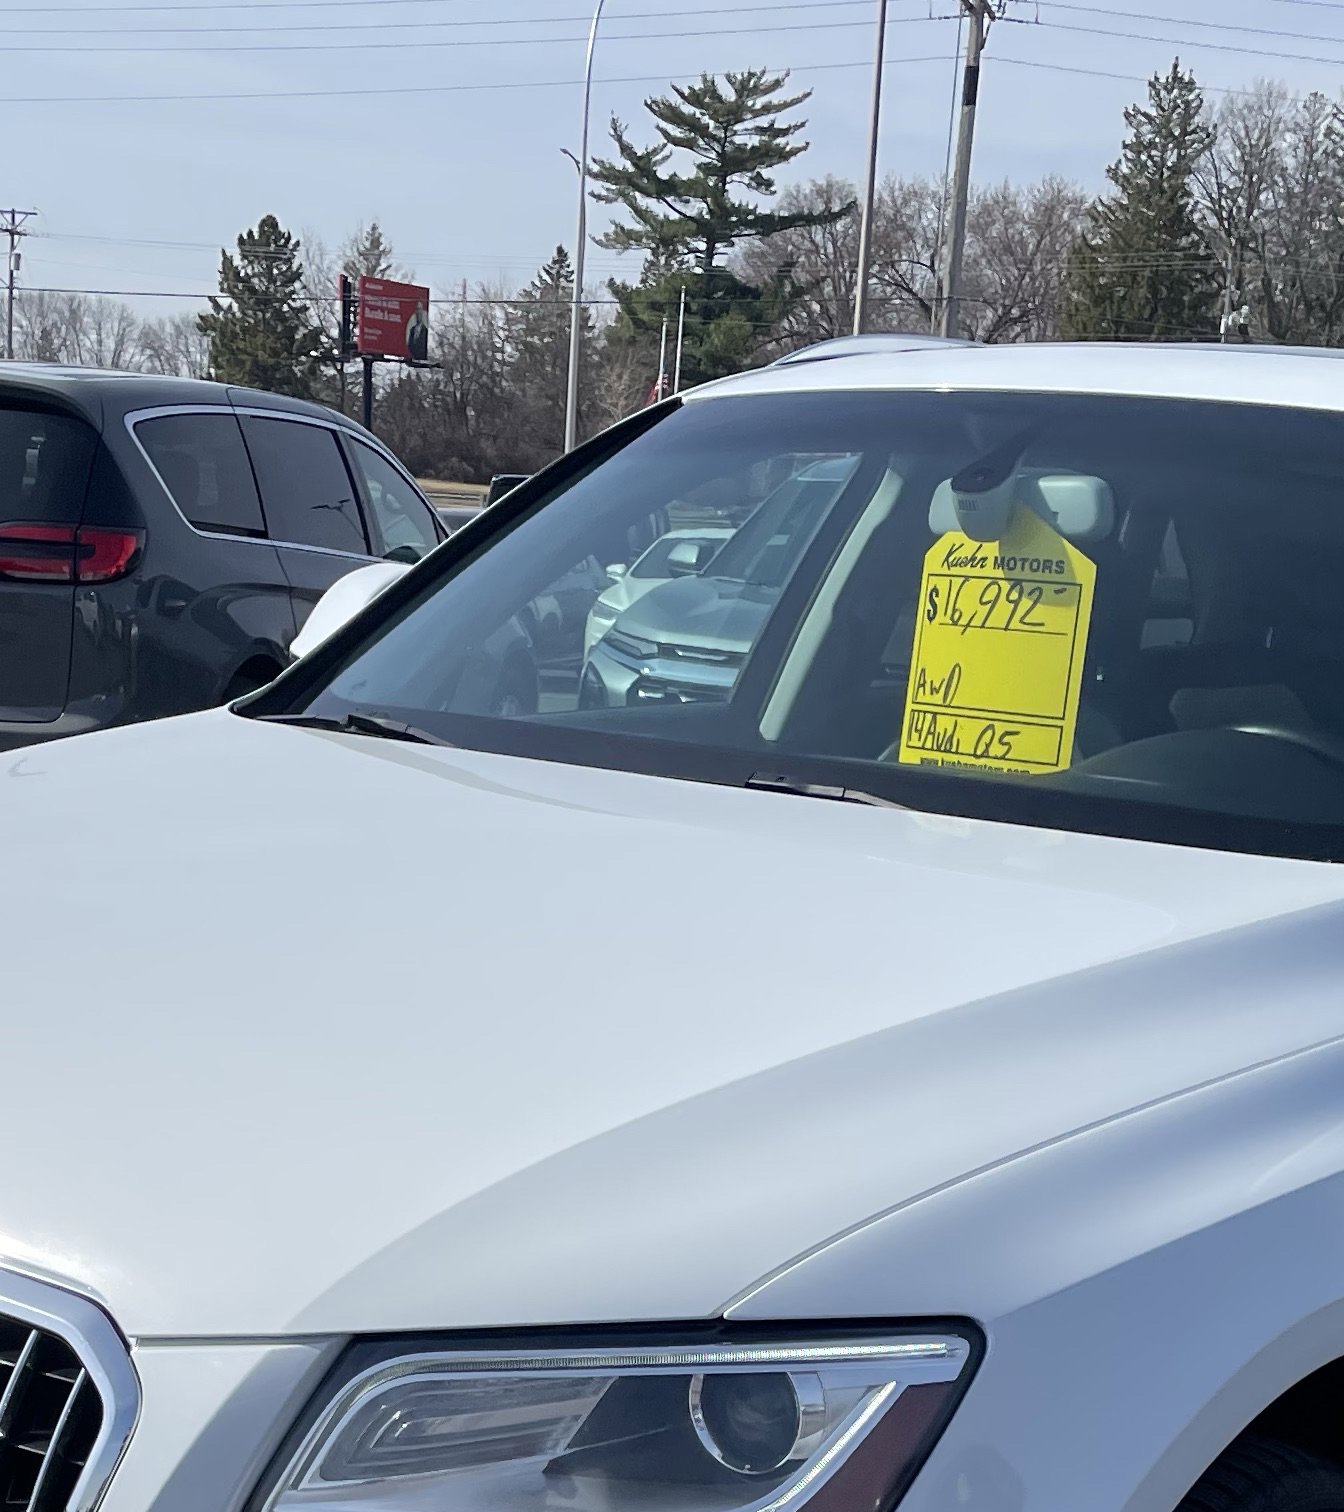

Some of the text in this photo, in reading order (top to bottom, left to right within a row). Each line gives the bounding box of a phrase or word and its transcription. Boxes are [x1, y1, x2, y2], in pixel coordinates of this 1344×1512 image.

[941, 543, 1065, 574] Kuehn MOTORS
[973, 723, 1021, 759] Q5
